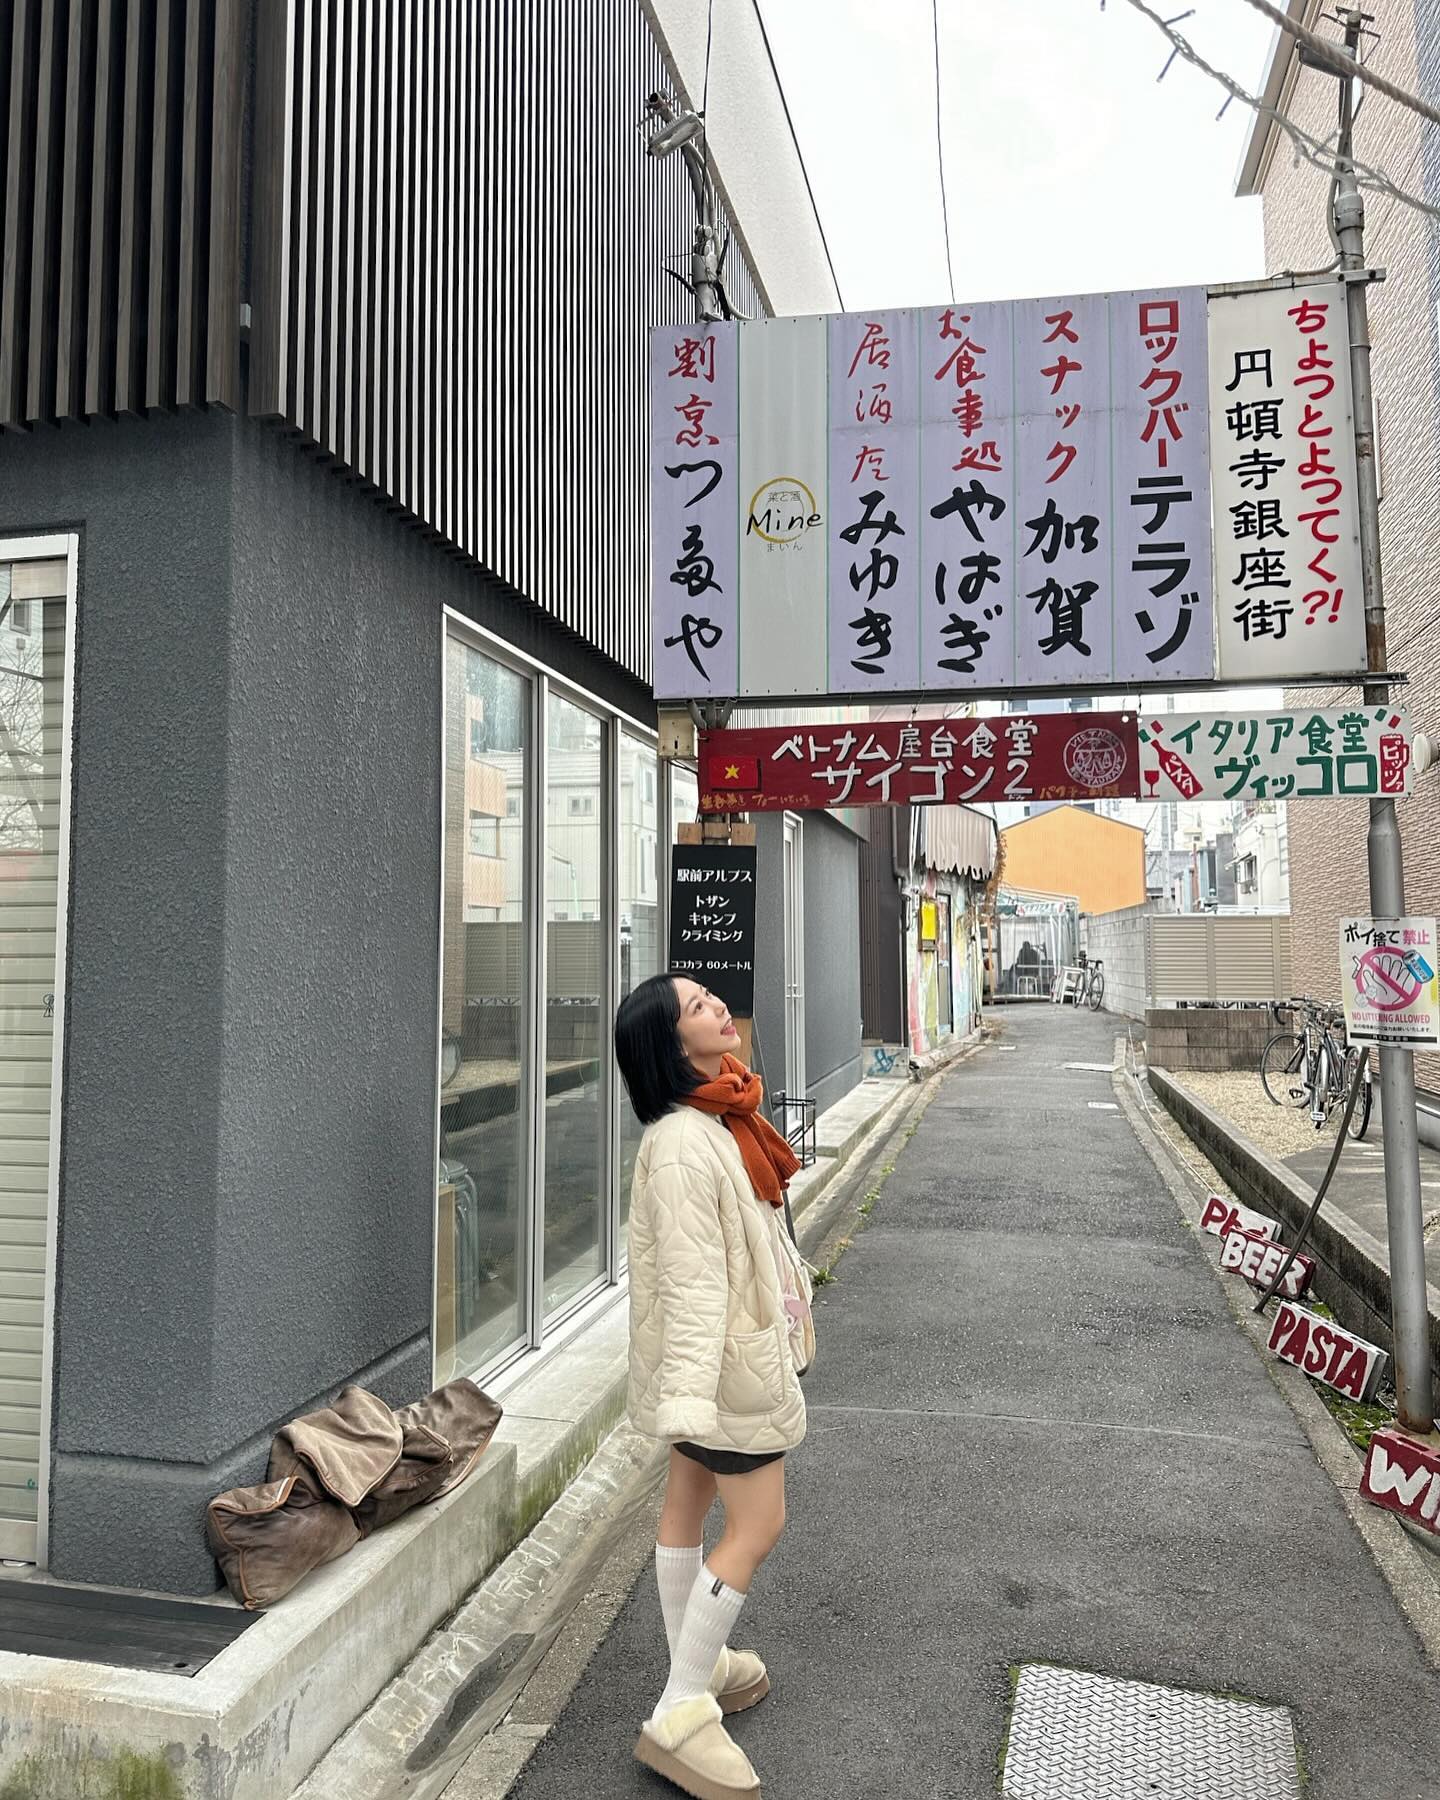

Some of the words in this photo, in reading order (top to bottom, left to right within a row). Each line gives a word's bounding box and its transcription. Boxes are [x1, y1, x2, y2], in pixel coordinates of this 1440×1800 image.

[1225, 349, 1293, 642] 円頓寺銀座街
[747, 509, 824, 535] Mine
[772, 719, 1037, 762] ベトナム屋台食堂
[1171, 712, 1370, 756] イタリア食堂
[1165, 754, 1193, 794] パスタ
[1214, 754, 1379, 798] ヴィッコロ
[677, 869, 752, 883] 駅前アルプス
[696, 895, 730, 908] トザン
[688, 913, 737, 926] キャンプ
[681, 930, 744, 943] クライミング
[671, 960, 703, 970] ココカラ
[706, 960, 752, 971] 60メートル
[1351, 1011, 1362, 1021] NO
[1362, 1012, 1394, 1023] LITTERING
[1395, 1014, 1431, 1024] ALLOWED
[1221, 1232, 1306, 1295] BEER
[1269, 1306, 1368, 1398] PASTA
